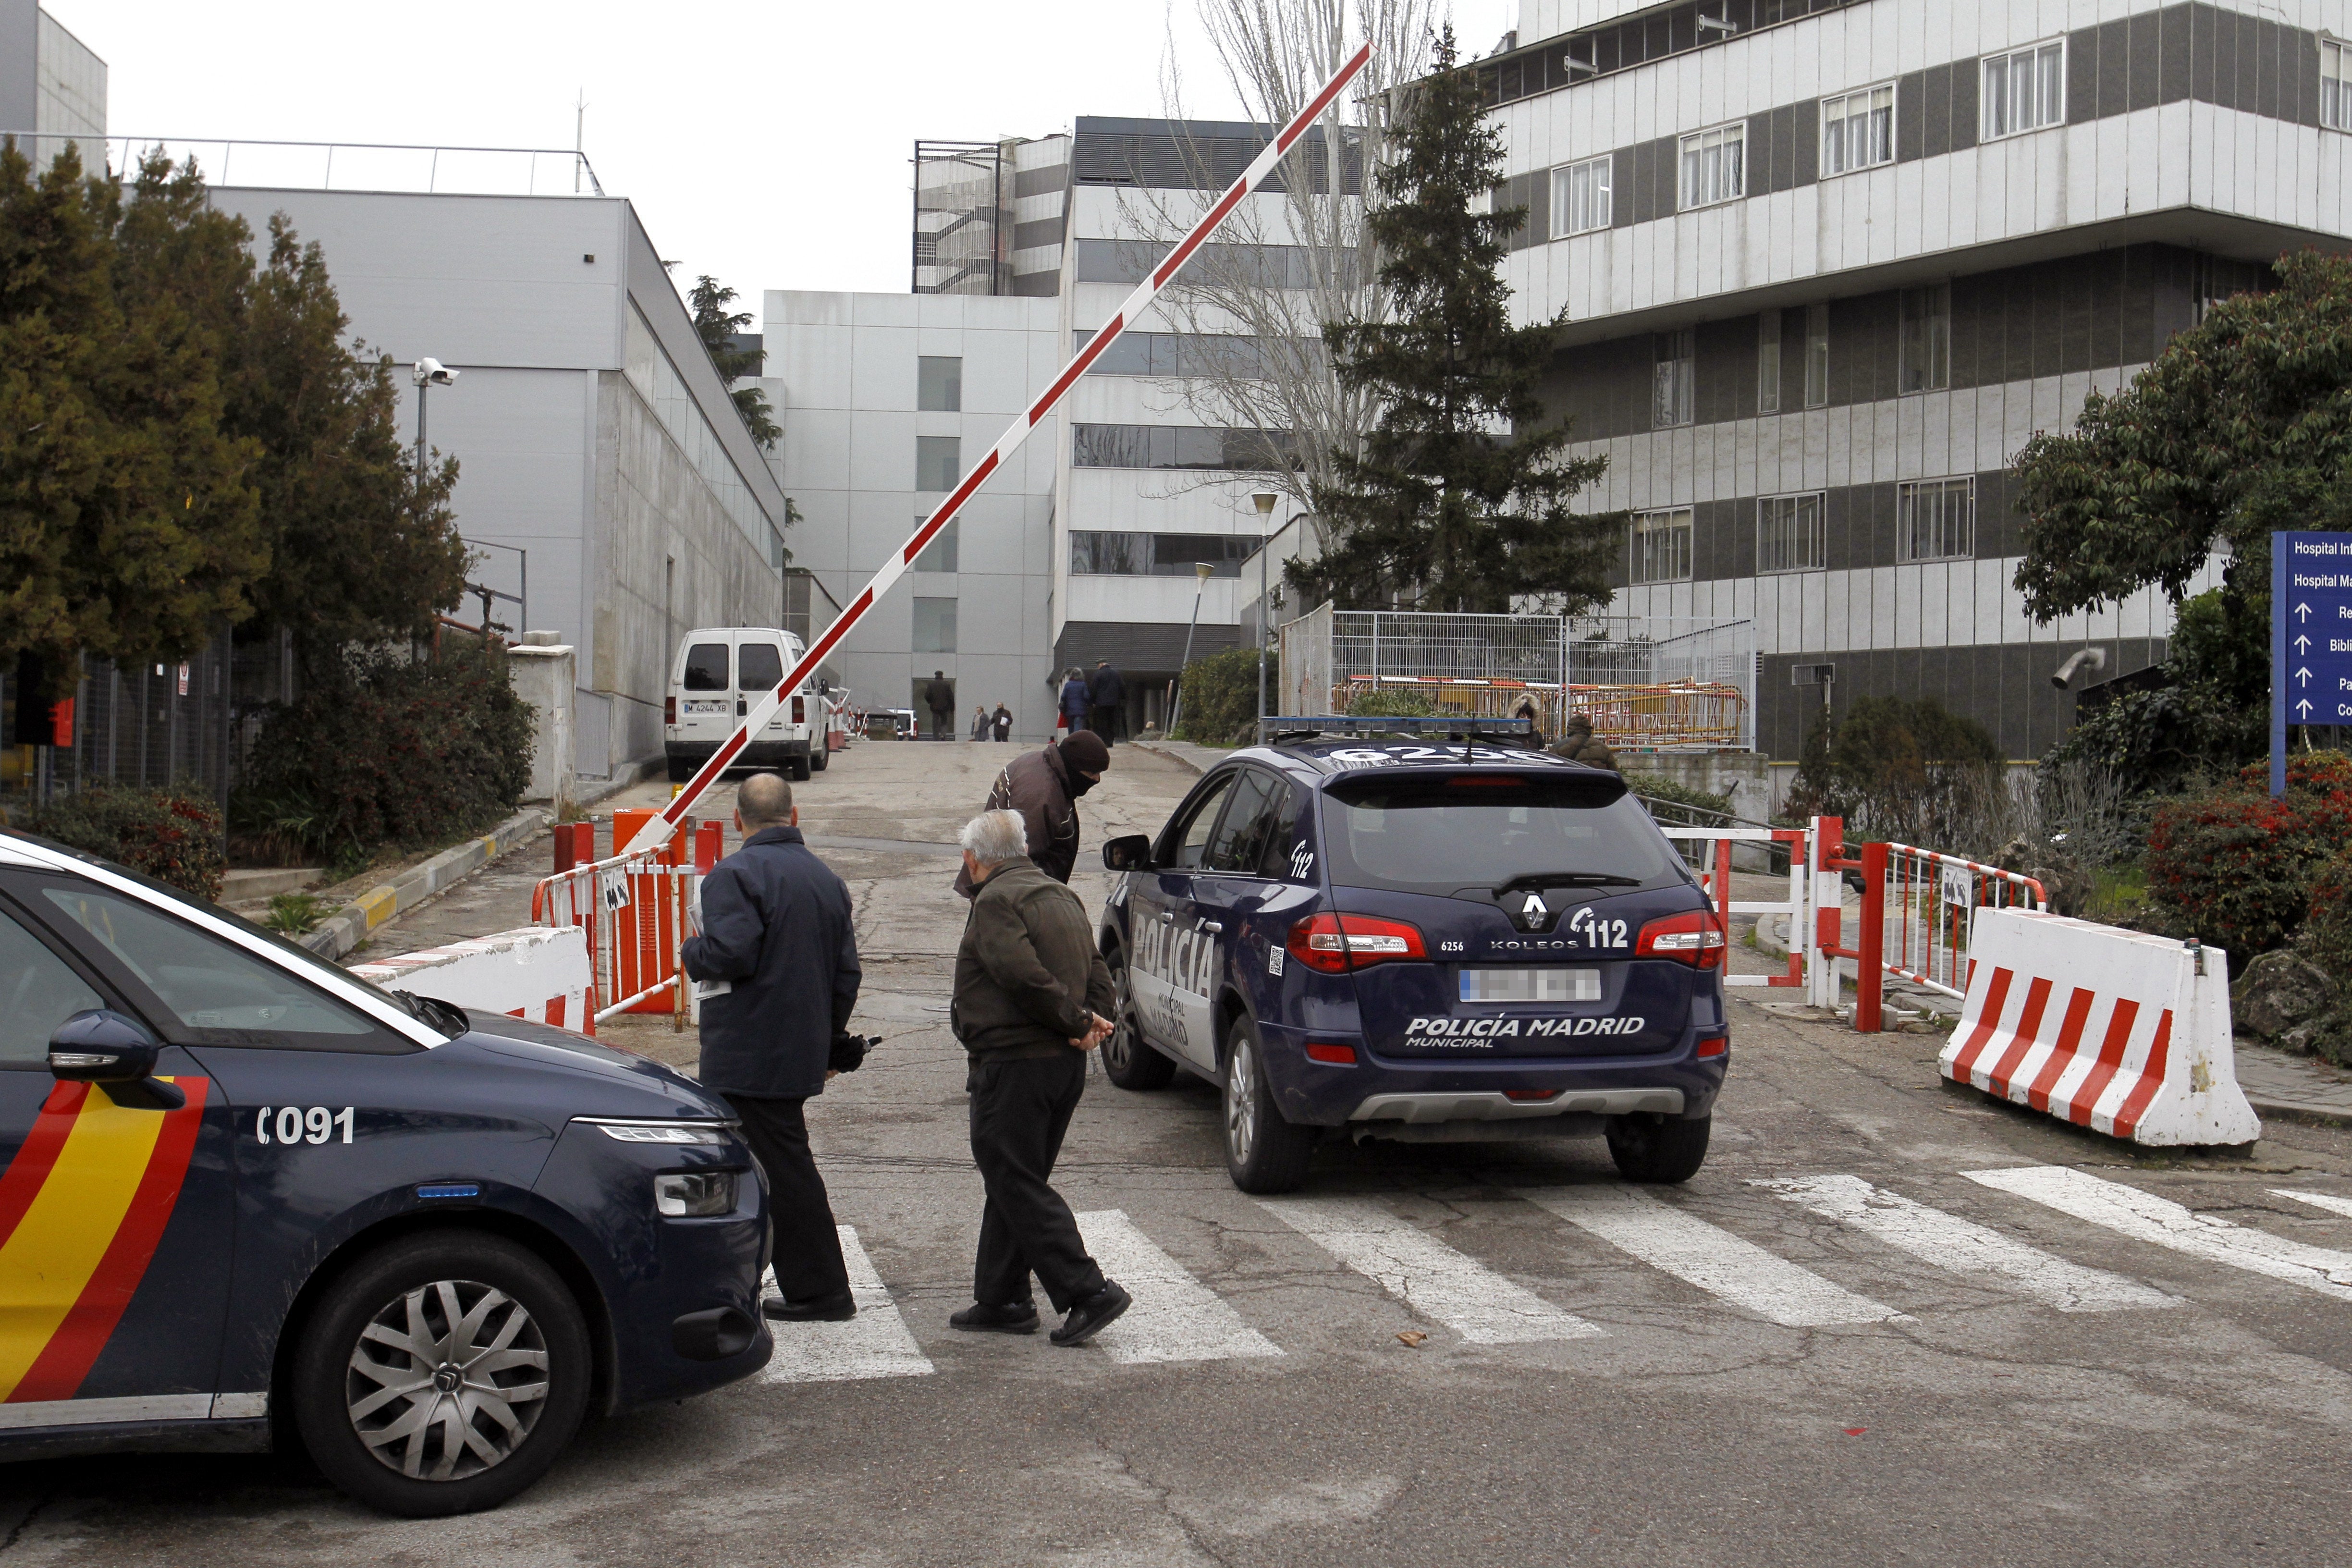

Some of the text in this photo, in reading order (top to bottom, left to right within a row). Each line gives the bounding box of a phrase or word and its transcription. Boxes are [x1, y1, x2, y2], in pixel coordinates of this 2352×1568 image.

[2294, 541, 2337, 557] Hospital
[2294, 574, 2337, 589] Hospital
[2339, 606, 2352, 619] Re
[2330, 638, 2352, 651] Bibli
[2340, 678, 2352, 691] Pa
[2338, 703, 2352, 716] Co
[1329, 746, 1565, 764] 6256
[1291, 852, 1314, 879] 112
[1584, 919, 1628, 948] 112
[1441, 941, 1464, 952] 6256
[1490, 940, 1579, 950] KOLEOS
[1131, 913, 1215, 1001] POLICÍA
[1149, 1005, 1188, 1046] MADRID
[1405, 1012, 1645, 1037] POLICÍA MADRID
[1406, 1038, 1494, 1048] MUNICIPAL
[276, 1106, 354, 1144] 091
